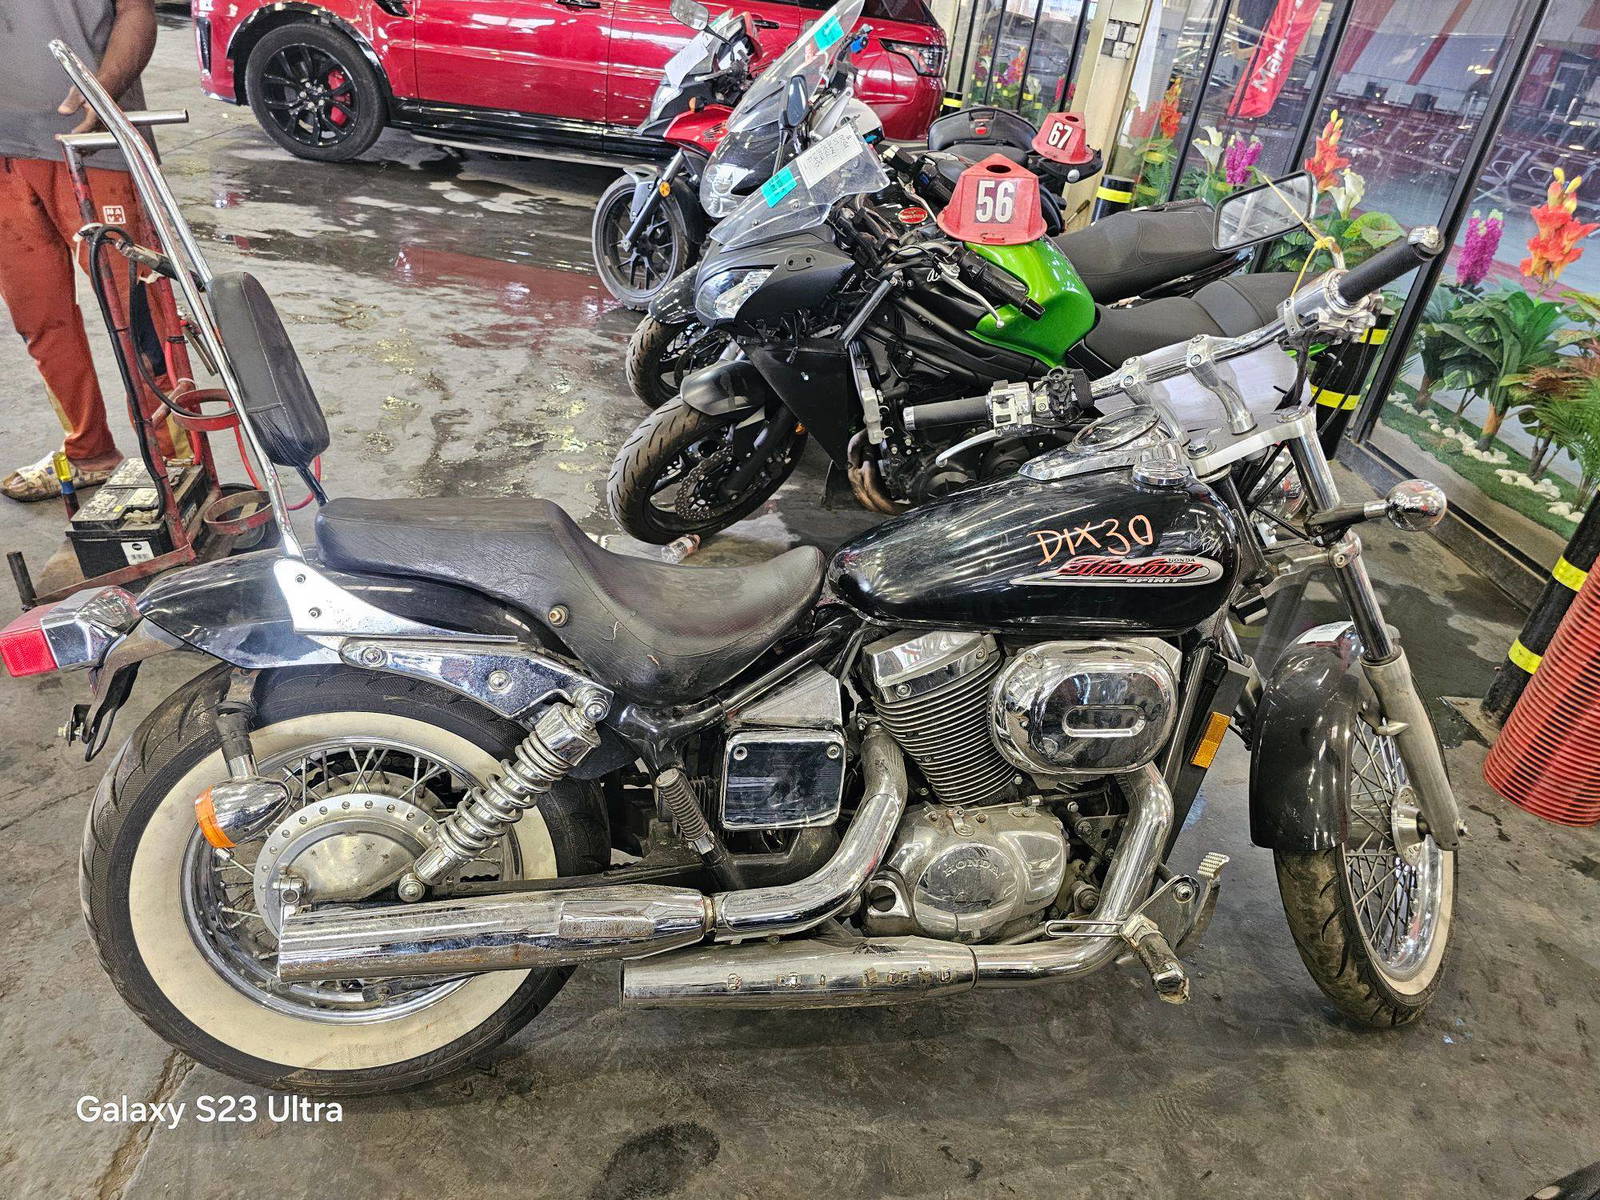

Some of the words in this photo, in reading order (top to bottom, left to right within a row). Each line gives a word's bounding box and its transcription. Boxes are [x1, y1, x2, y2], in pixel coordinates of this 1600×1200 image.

[1047, 122, 1073, 149] 67
[976, 180, 1015, 223] 56
[943, 859, 1004, 880] HONDA
